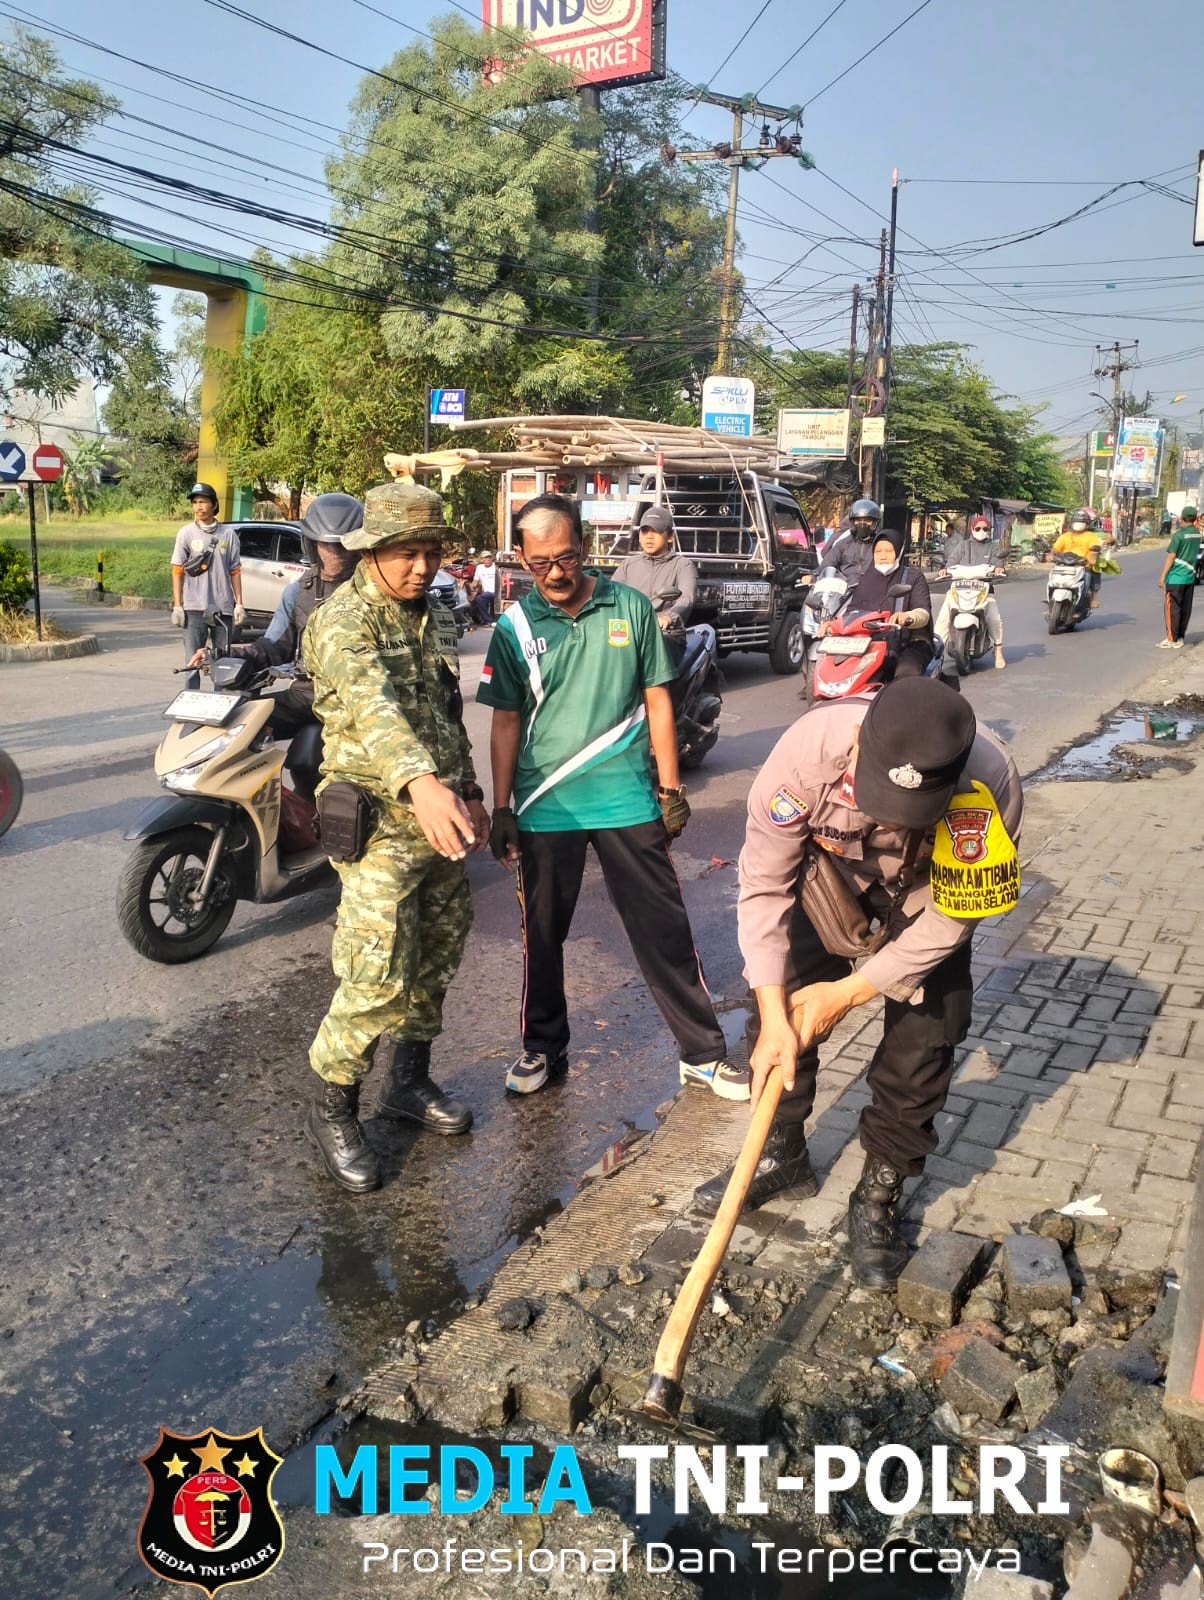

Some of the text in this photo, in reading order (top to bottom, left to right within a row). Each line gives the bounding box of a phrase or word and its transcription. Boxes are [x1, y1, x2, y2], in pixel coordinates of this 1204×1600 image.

[714, 416, 746, 425] ELECTRIC
[717, 424, 746, 433] VEHICLE
[239, 761, 269, 777] HONDA
[944, 896, 982, 911] TAMBUN
[984, 889, 1019, 909] SELATAN
